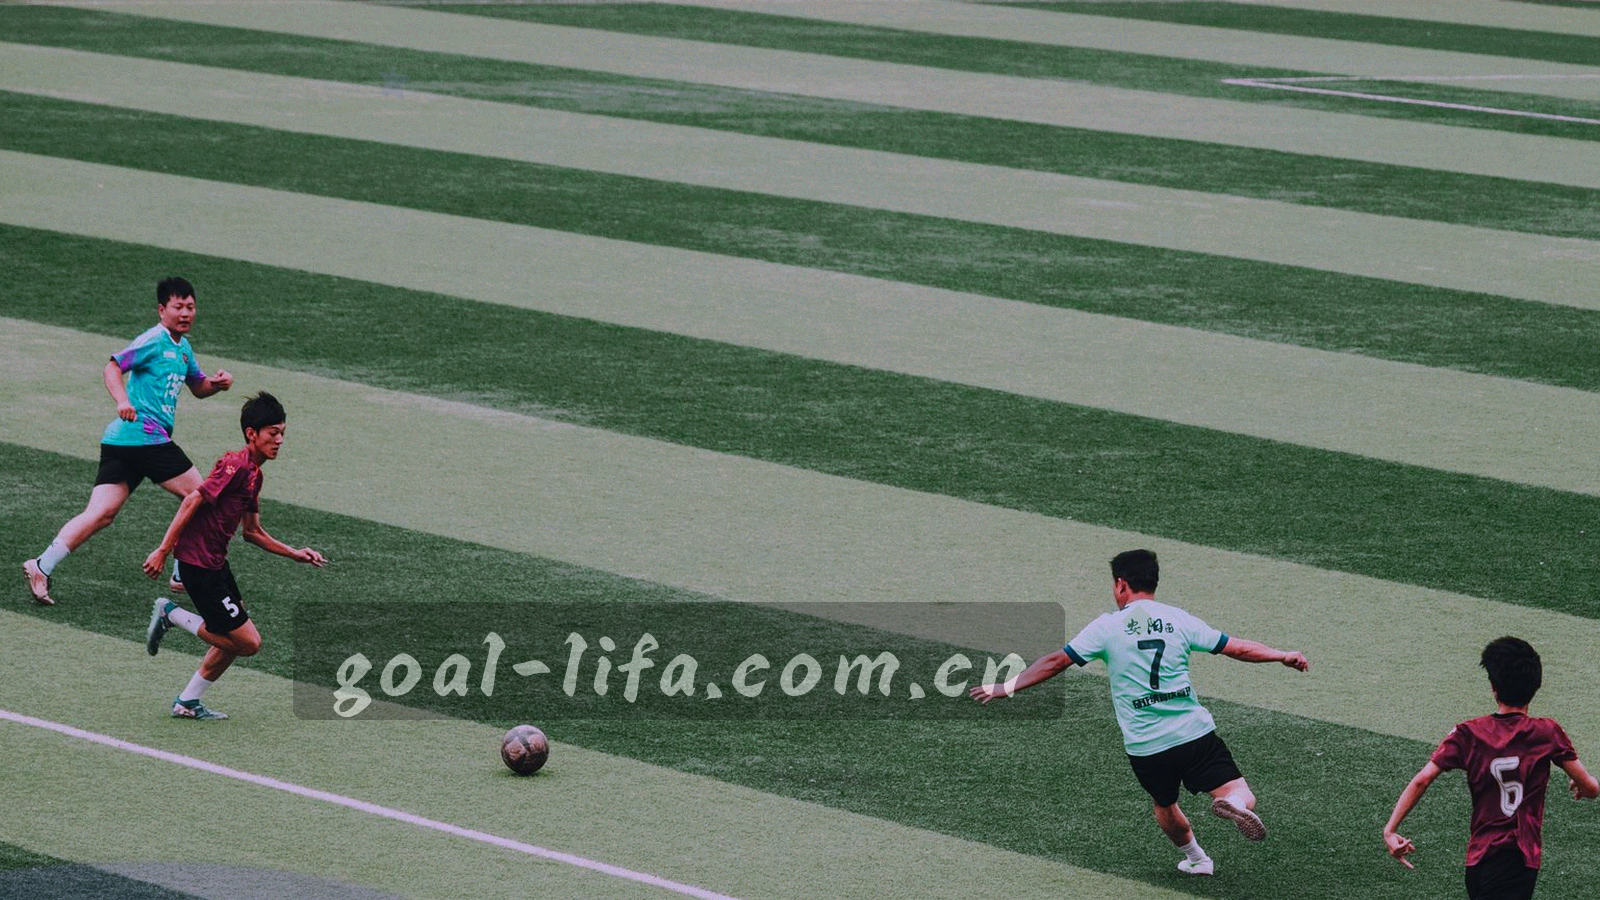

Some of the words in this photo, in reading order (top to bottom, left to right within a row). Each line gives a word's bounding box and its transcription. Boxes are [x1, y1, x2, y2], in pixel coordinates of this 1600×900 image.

[222, 596, 239, 617] 5
[1137, 638, 1166, 690] 7
[1490, 756, 1523, 817] 6
